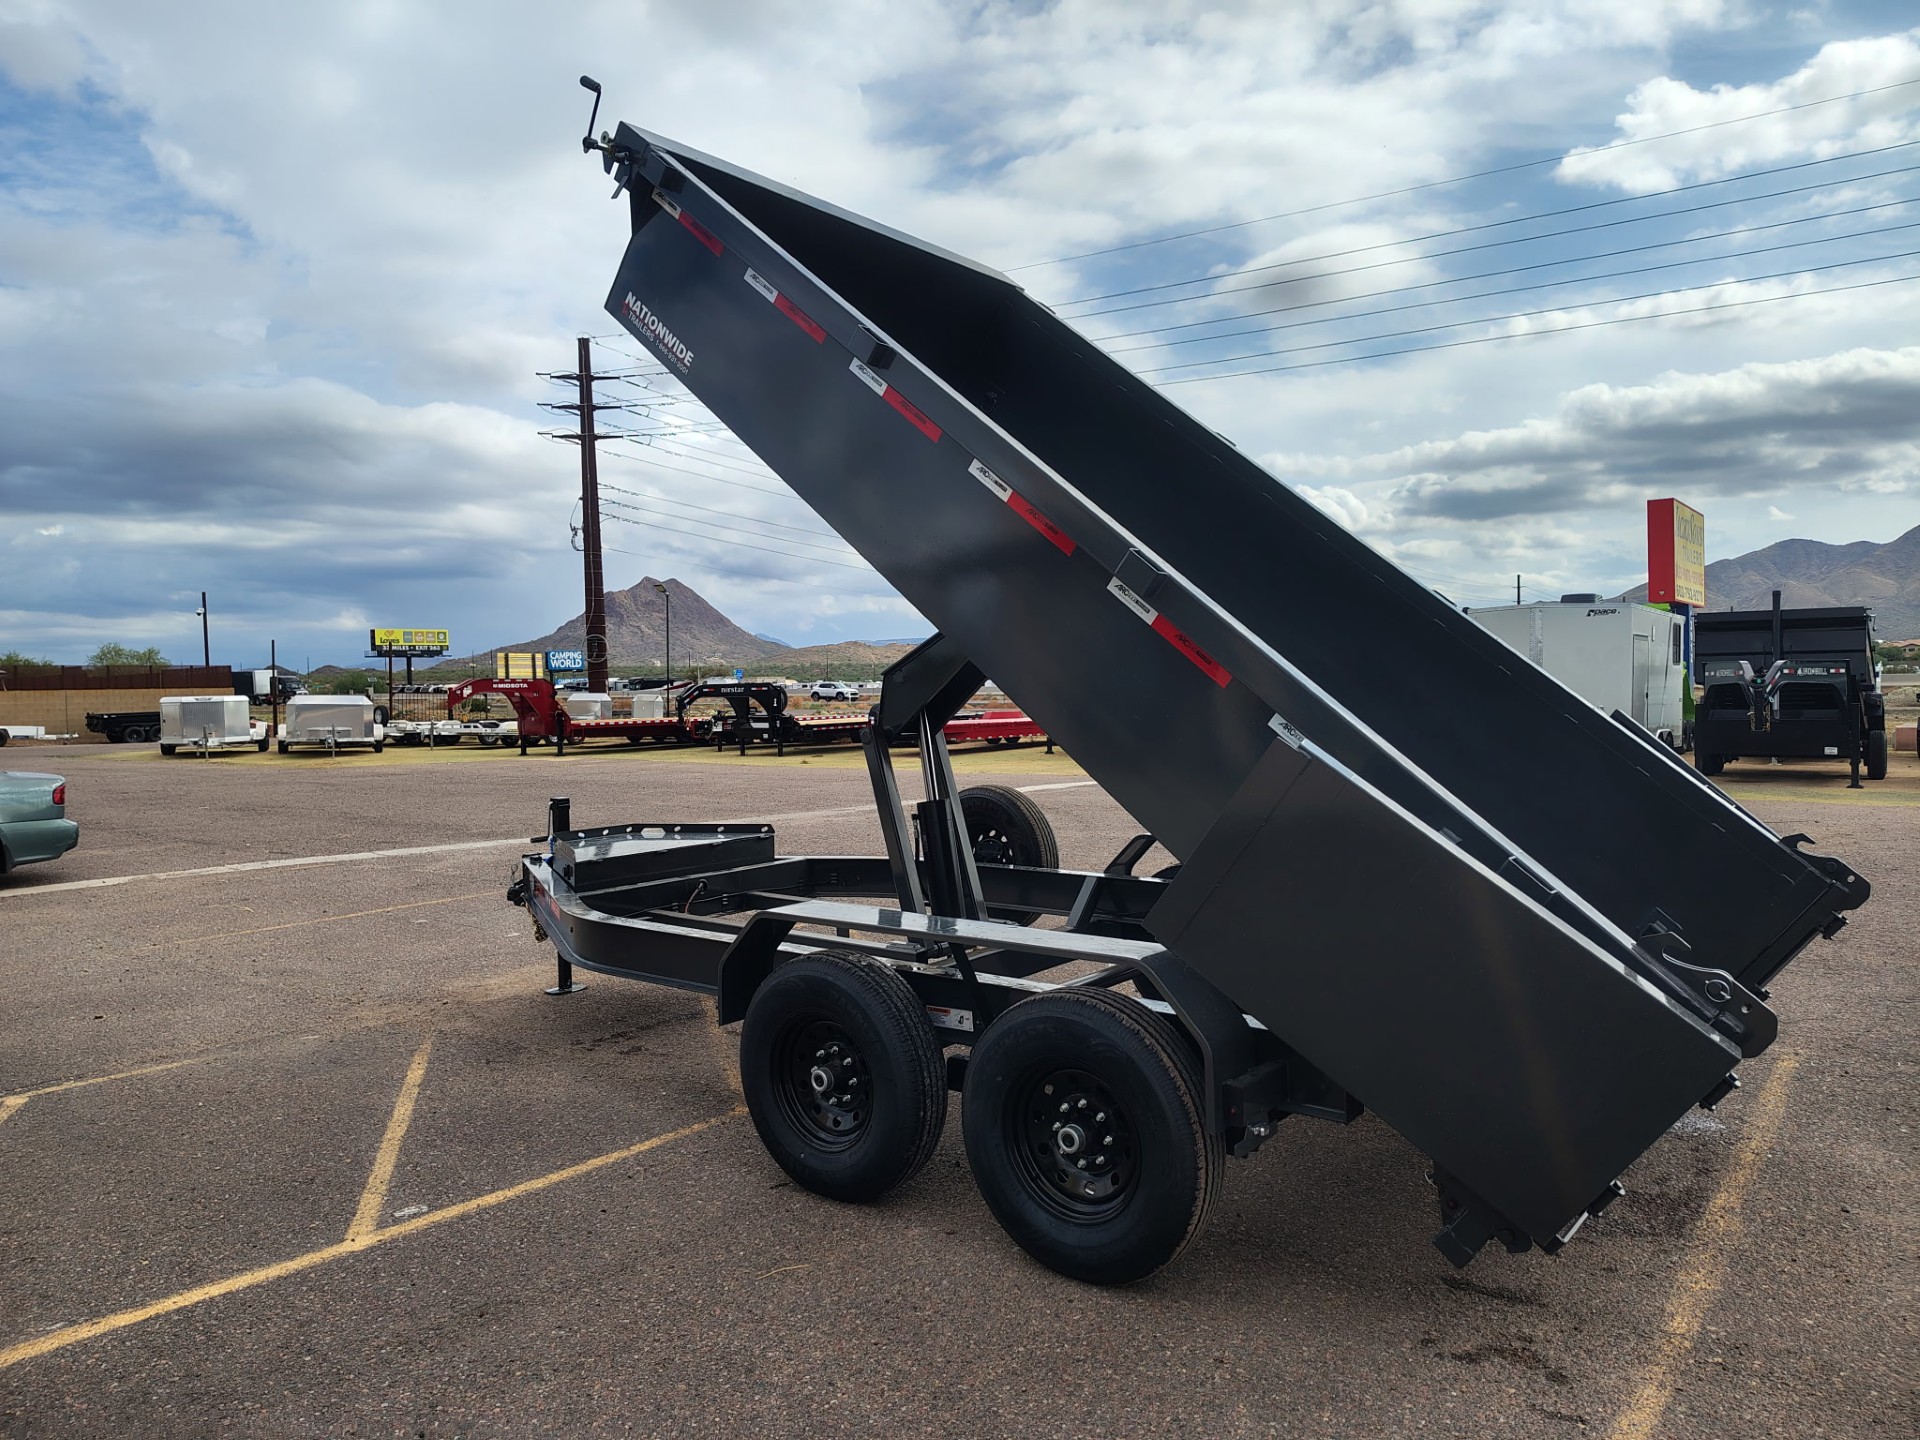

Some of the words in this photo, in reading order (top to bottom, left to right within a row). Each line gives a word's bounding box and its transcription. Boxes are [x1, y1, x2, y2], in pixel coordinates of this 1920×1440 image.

[624, 291, 694, 367] NATIONWIDE
[628, 310, 655, 342] TRAILERS
[550, 651, 582, 660] CAMPING
[550, 659, 582, 668] WORLD
